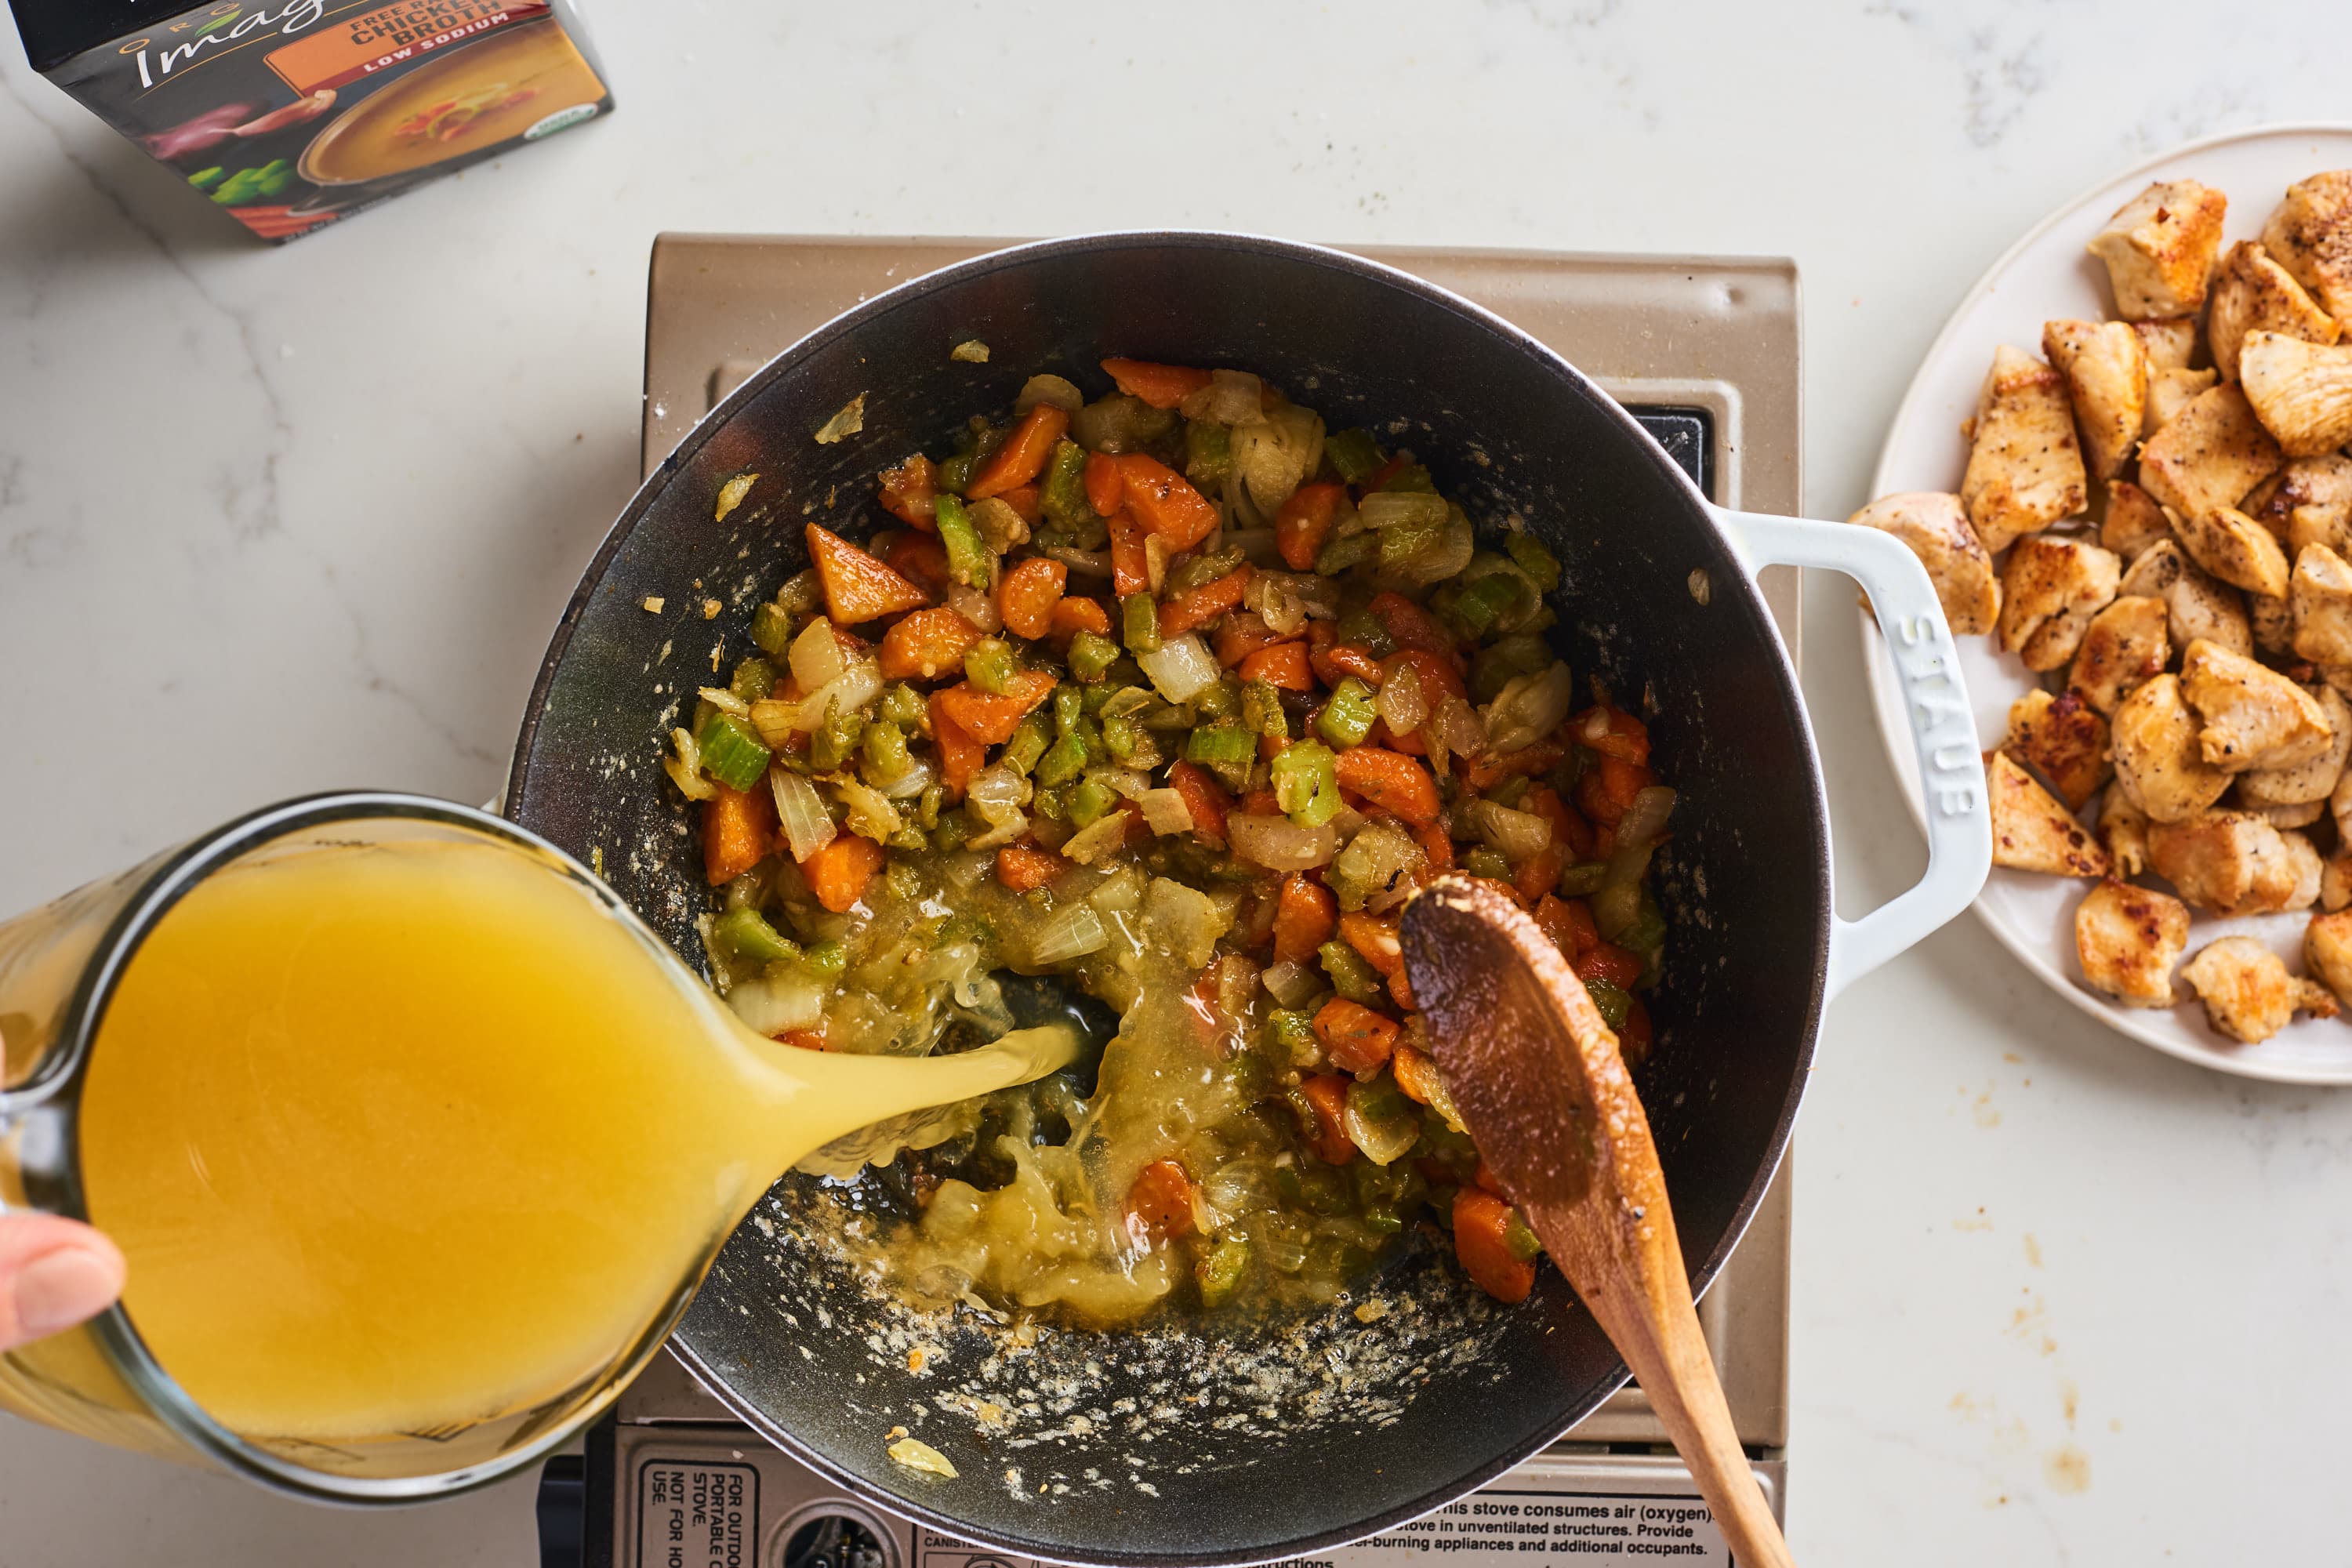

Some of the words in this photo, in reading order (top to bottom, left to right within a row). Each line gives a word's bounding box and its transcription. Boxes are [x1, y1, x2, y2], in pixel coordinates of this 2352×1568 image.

[350, 5, 406, 31] FREE
[391, 0, 503, 46] BROTH
[363, 48, 412, 73] LOW
[420, 12, 510, 50] SODIUM
[1896, 614, 1976, 817] STAUB
[652, 1471, 667, 1506] USE.
[670, 1472, 685, 1504] NOT
[691, 1472, 707, 1527] STOVE.
[728, 1474, 743, 1507] FOR
[669, 1508, 684, 1542] FOR
[709, 1473, 726, 1556] PORTABLE
[1473, 1502, 1519, 1515] stove
[1523, 1504, 1610, 1519] consumes
[1614, 1504, 1636, 1519] air
[727, 1512, 742, 1568] OUTDO
[1439, 1519, 1454, 1532] in
[1458, 1521, 1549, 1534] unventilated
[1553, 1523, 1632, 1537] structures.
[1637, 1524, 1694, 1538] Provide
[1434, 1537, 1514, 1552] appliances
[1519, 1540, 1546, 1552] and
[1550, 1540, 1623, 1553] additional
[1627, 1542, 1708, 1557] occupants.
